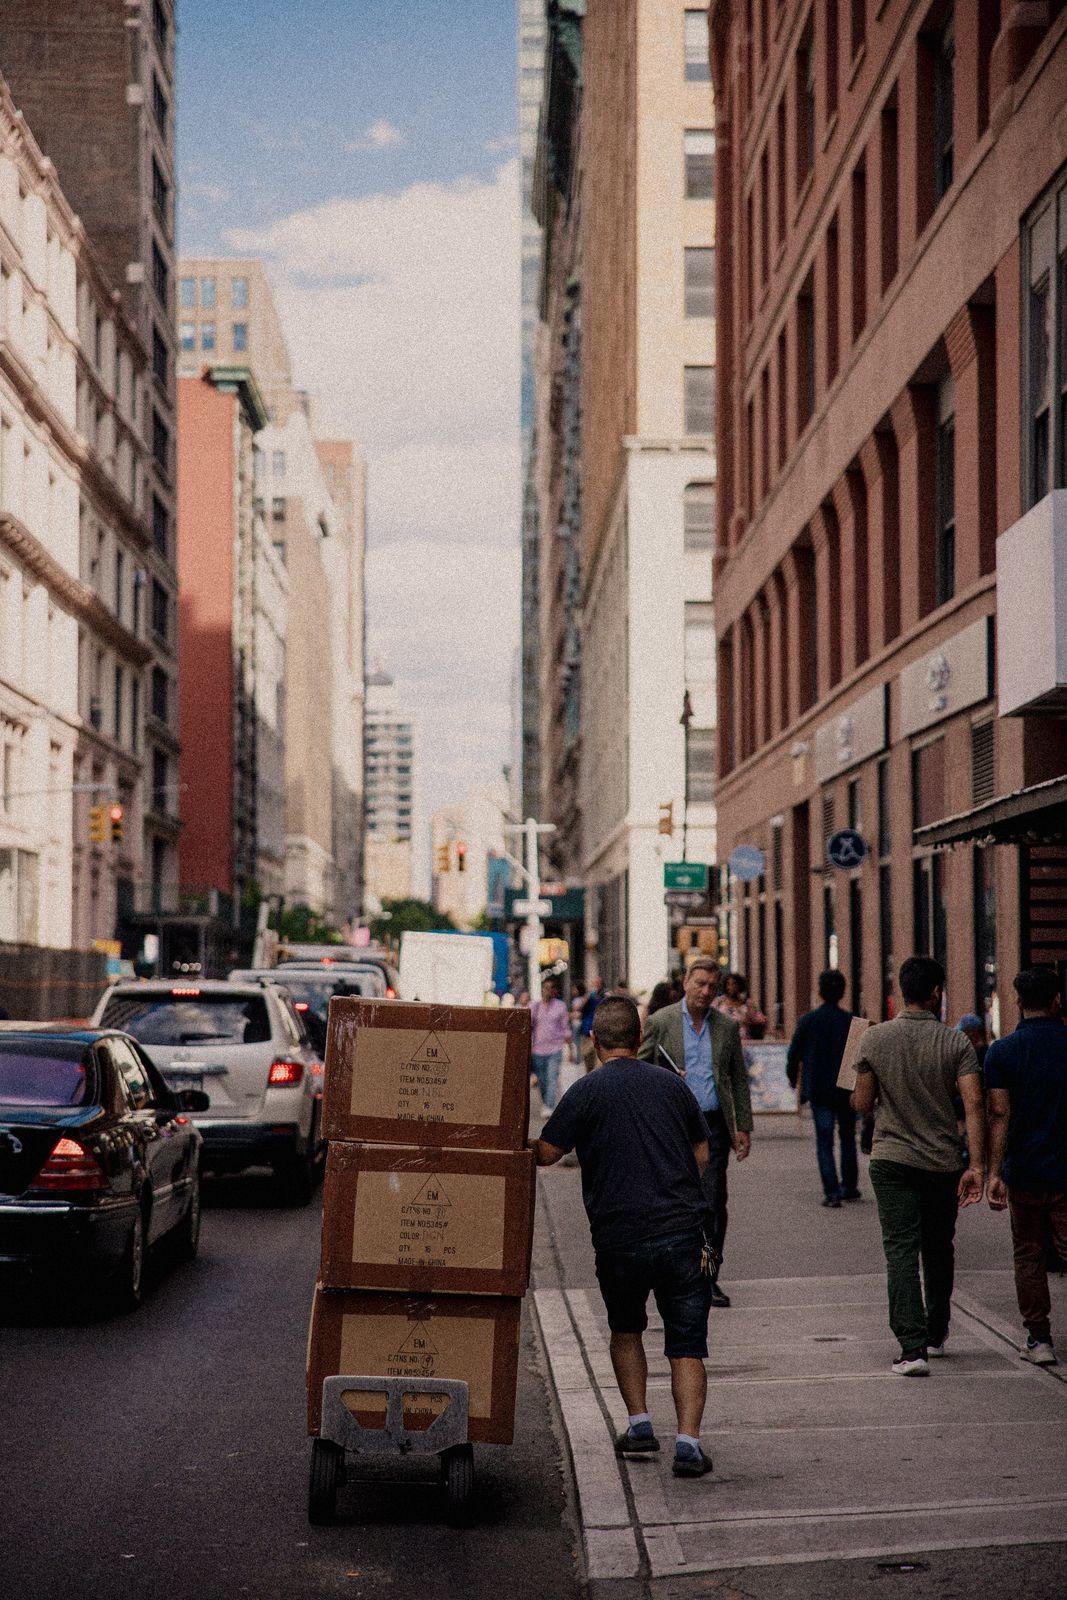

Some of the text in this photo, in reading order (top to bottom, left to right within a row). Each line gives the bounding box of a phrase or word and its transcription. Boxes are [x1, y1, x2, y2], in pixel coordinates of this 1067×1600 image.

[426, 1048, 438, 1057] EM
[399, 1075, 415, 1083] ITEM
[397, 1100, 410, 1108] QTY
[442, 1102, 455, 1111] PCS
[397, 1113, 445, 1122] MADE IN CHINA
[427, 1190, 439, 1200] EM
[400, 1219, 416, 1227] ITEM
[398, 1244, 410, 1252] QTY
[443, 1246, 456, 1254] PCS
[398, 1257, 416, 1265] MADE
[427, 1259, 446, 1267] CHINA
[413, 1338, 426, 1348] EM
[387, 1367, 402, 1376] ITEM
